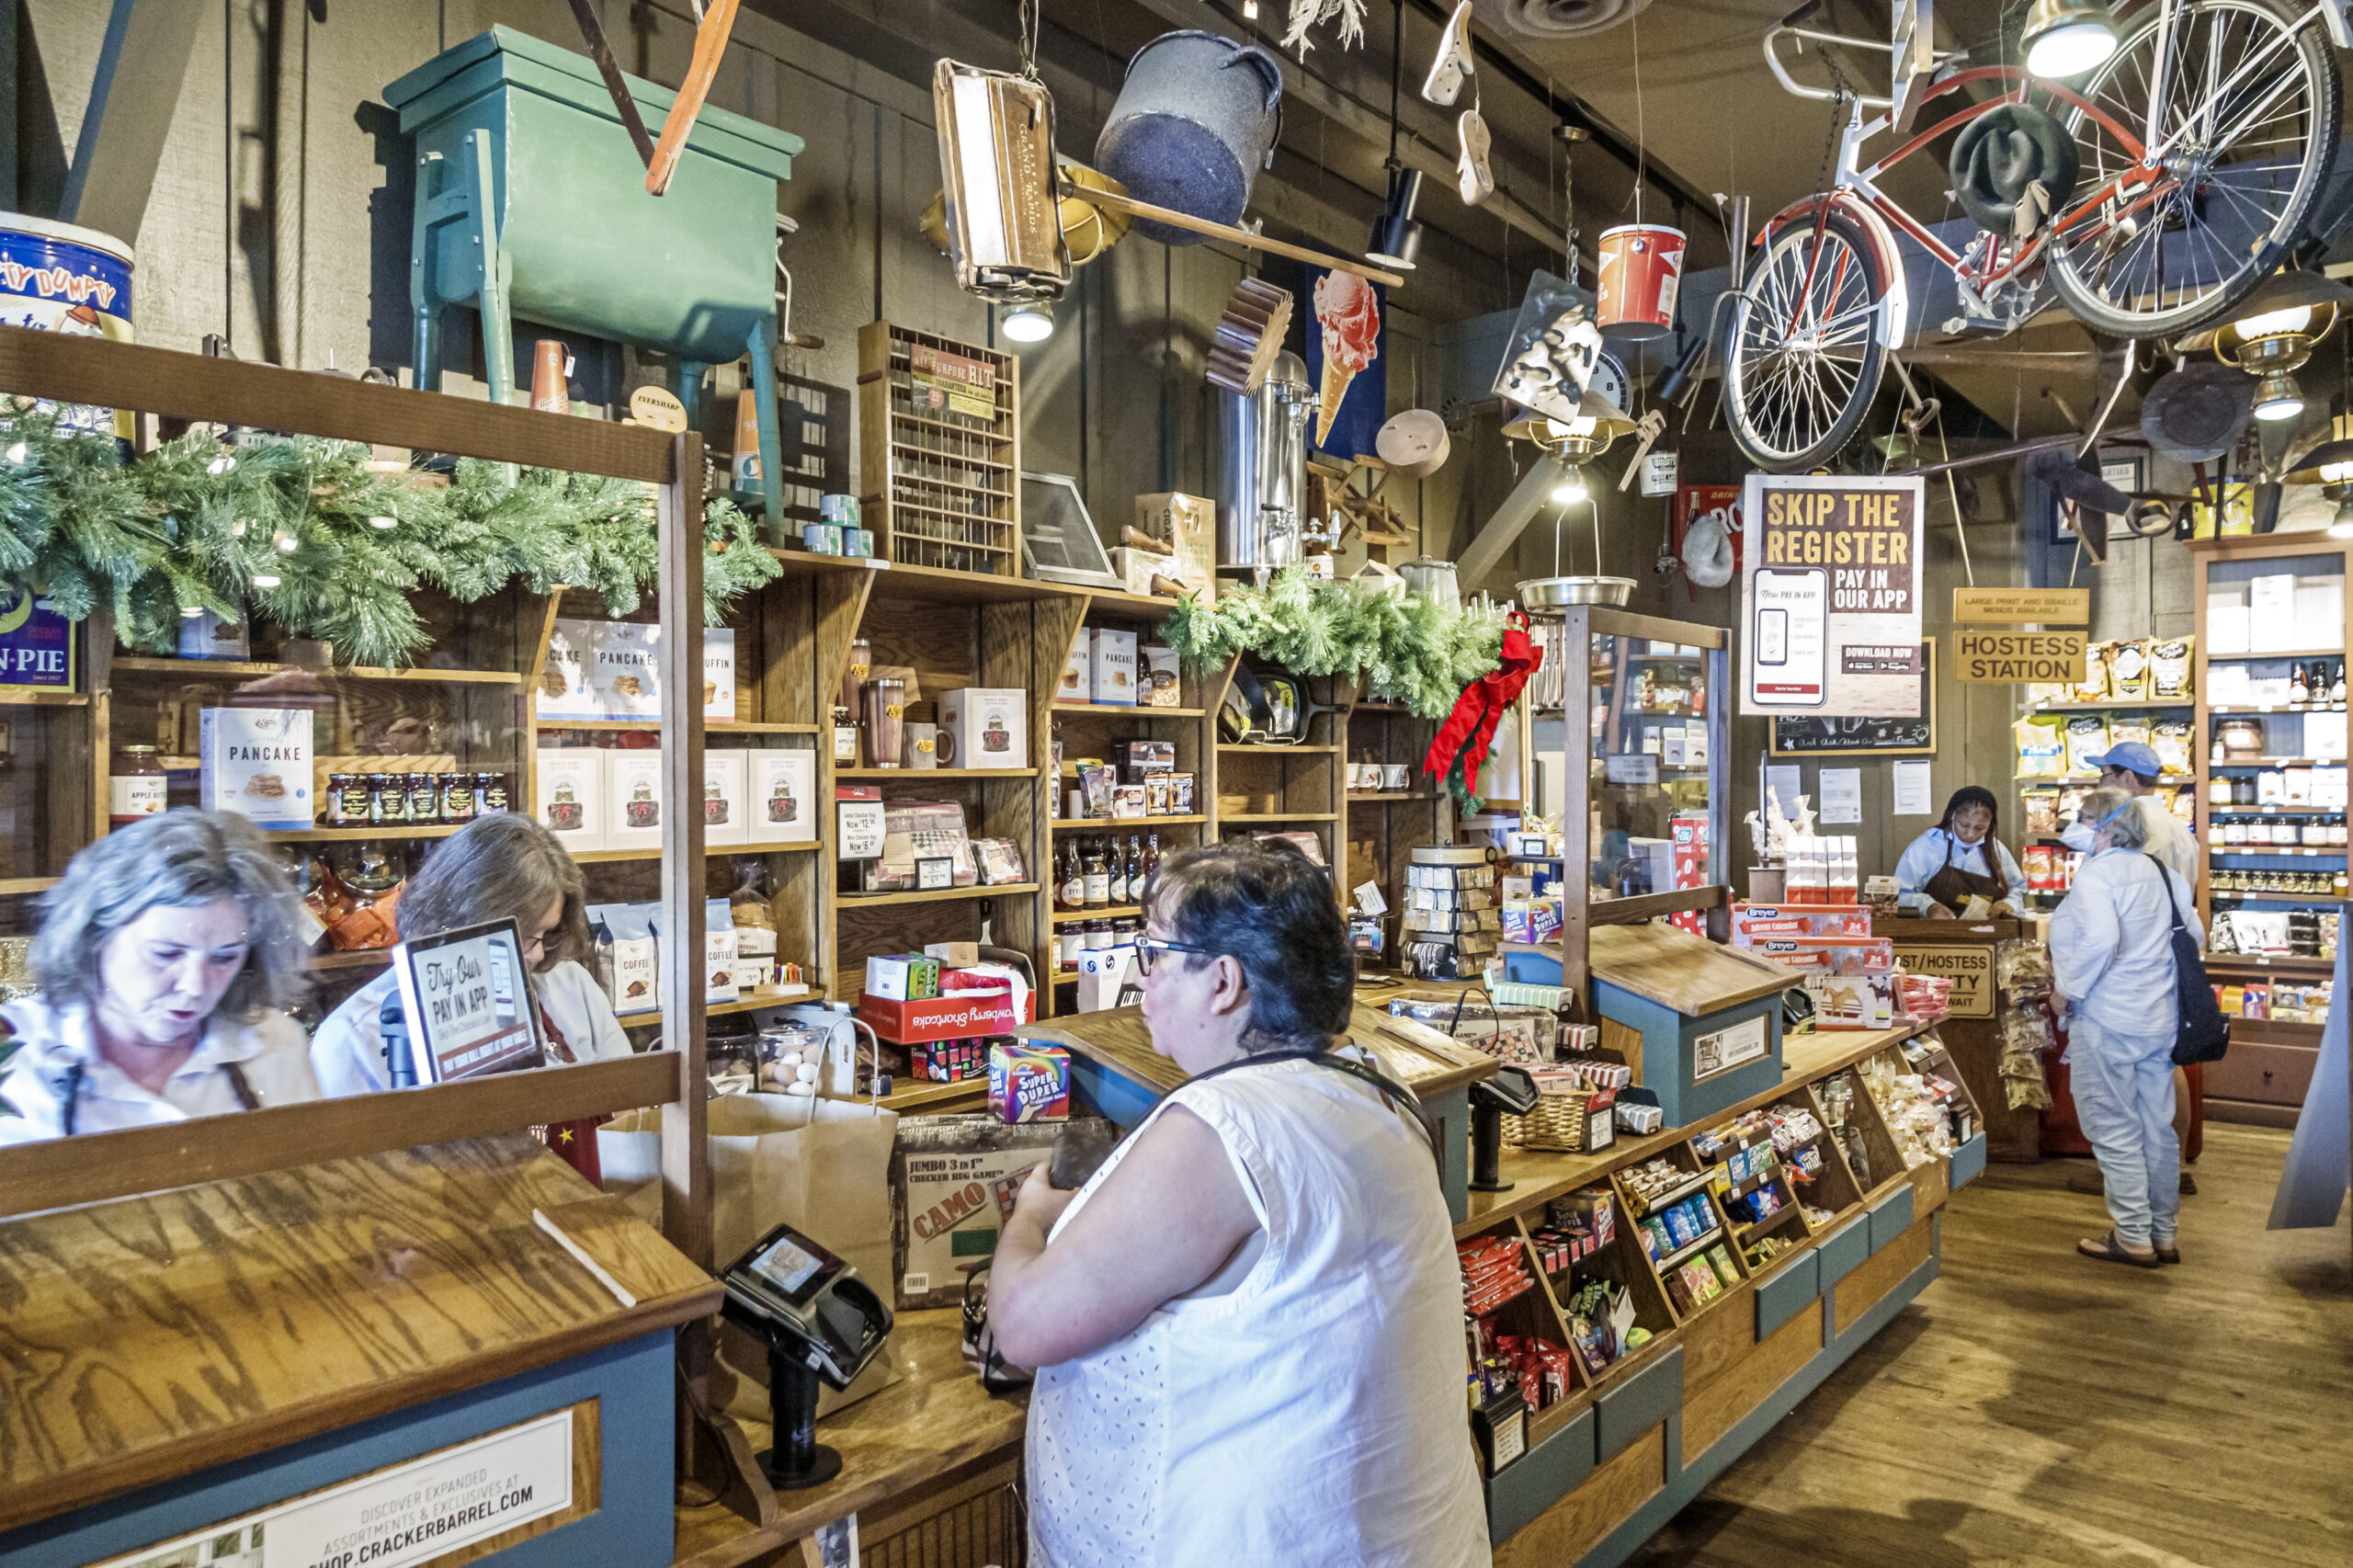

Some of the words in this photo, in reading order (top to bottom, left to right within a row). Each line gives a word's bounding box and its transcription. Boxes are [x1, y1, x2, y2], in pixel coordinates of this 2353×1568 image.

[1018, 123, 1031, 174] GRAND
[1025, 181, 1037, 234] RAPIDS
[35, 267, 117, 309] DUMPTY
[932, 360, 967, 380] PURPOSE
[968, 364, 994, 389] RIT
[638, 395, 680, 411] EVERSHARP
[1711, 490, 1739, 500] DRIN
[1768, 493, 1835, 526] SKIP
[1844, 494, 1900, 528] THE
[1163, 508, 1171, 540] CIGAR
[1767, 530, 1908, 565] REGISTER
[1835, 569, 1866, 588] PAY
[1870, 569, 1888, 589] IN
[1760, 589, 1779, 598] New
[1780, 591, 1793, 599] PAY
[1794, 591, 1802, 599] IN
[1802, 591, 1816, 599] APP
[1835, 589, 1869, 608] OUR
[1872, 589, 1907, 609] APP
[1845, 647, 1891, 658] DOWNLOAD
[1893, 648, 1913, 658] NOW
[1961, 637, 2080, 655] HOSTESS
[545, 650, 580, 663] CAKE
[599, 652, 653, 665] PANCAKE
[705, 659, 730, 668] UFFIN
[1072, 651, 1087, 660] UFFIN
[1106, 653, 1133, 664] PANCAKE
[1971, 659, 2071, 678] STATION
[230, 746, 301, 760] PANCAKE
[1749, 909, 1777, 918] Breyer
[1751, 922, 1771, 932] Advent
[1768, 941, 1796, 950] Breyer
[708, 950, 733, 960] COFFEE
[1893, 953, 1987, 971] OST/HOSTESS
[623, 958, 649, 970] COFFEE
[426, 962, 454, 994] Try
[457, 955, 483, 984] Our
[433, 996, 454, 1025] PAY
[454, 991, 467, 1017] IN
[469, 986, 488, 1013] APP
[913, 1011, 968, 1028] Shortcake
[970, 1006, 1029, 1023] Srawberry
[1018, 1071, 1054, 1091] SUPER
[1017, 1081, 1061, 1105] DUPER
[909, 1160, 947, 1175] JUMBO
[949, 1159, 959, 1170] 3
[909, 1172, 949, 1183] CHECKER
[951, 1171, 971, 1180] RUG
[914, 1182, 986, 1239] CAMO
[361, 1491, 422, 1525] DISCOVER
[426, 1469, 487, 1502] EXPANDED
[324, 1511, 415, 1556] ASSORTMENTS
[420, 1509, 428, 1520] &
[433, 1483, 502, 1516] EXCLUSIVES
[506, 1473, 520, 1490] AT
[309, 1485, 534, 1568] HOP.CRACKERBARREL.COM
